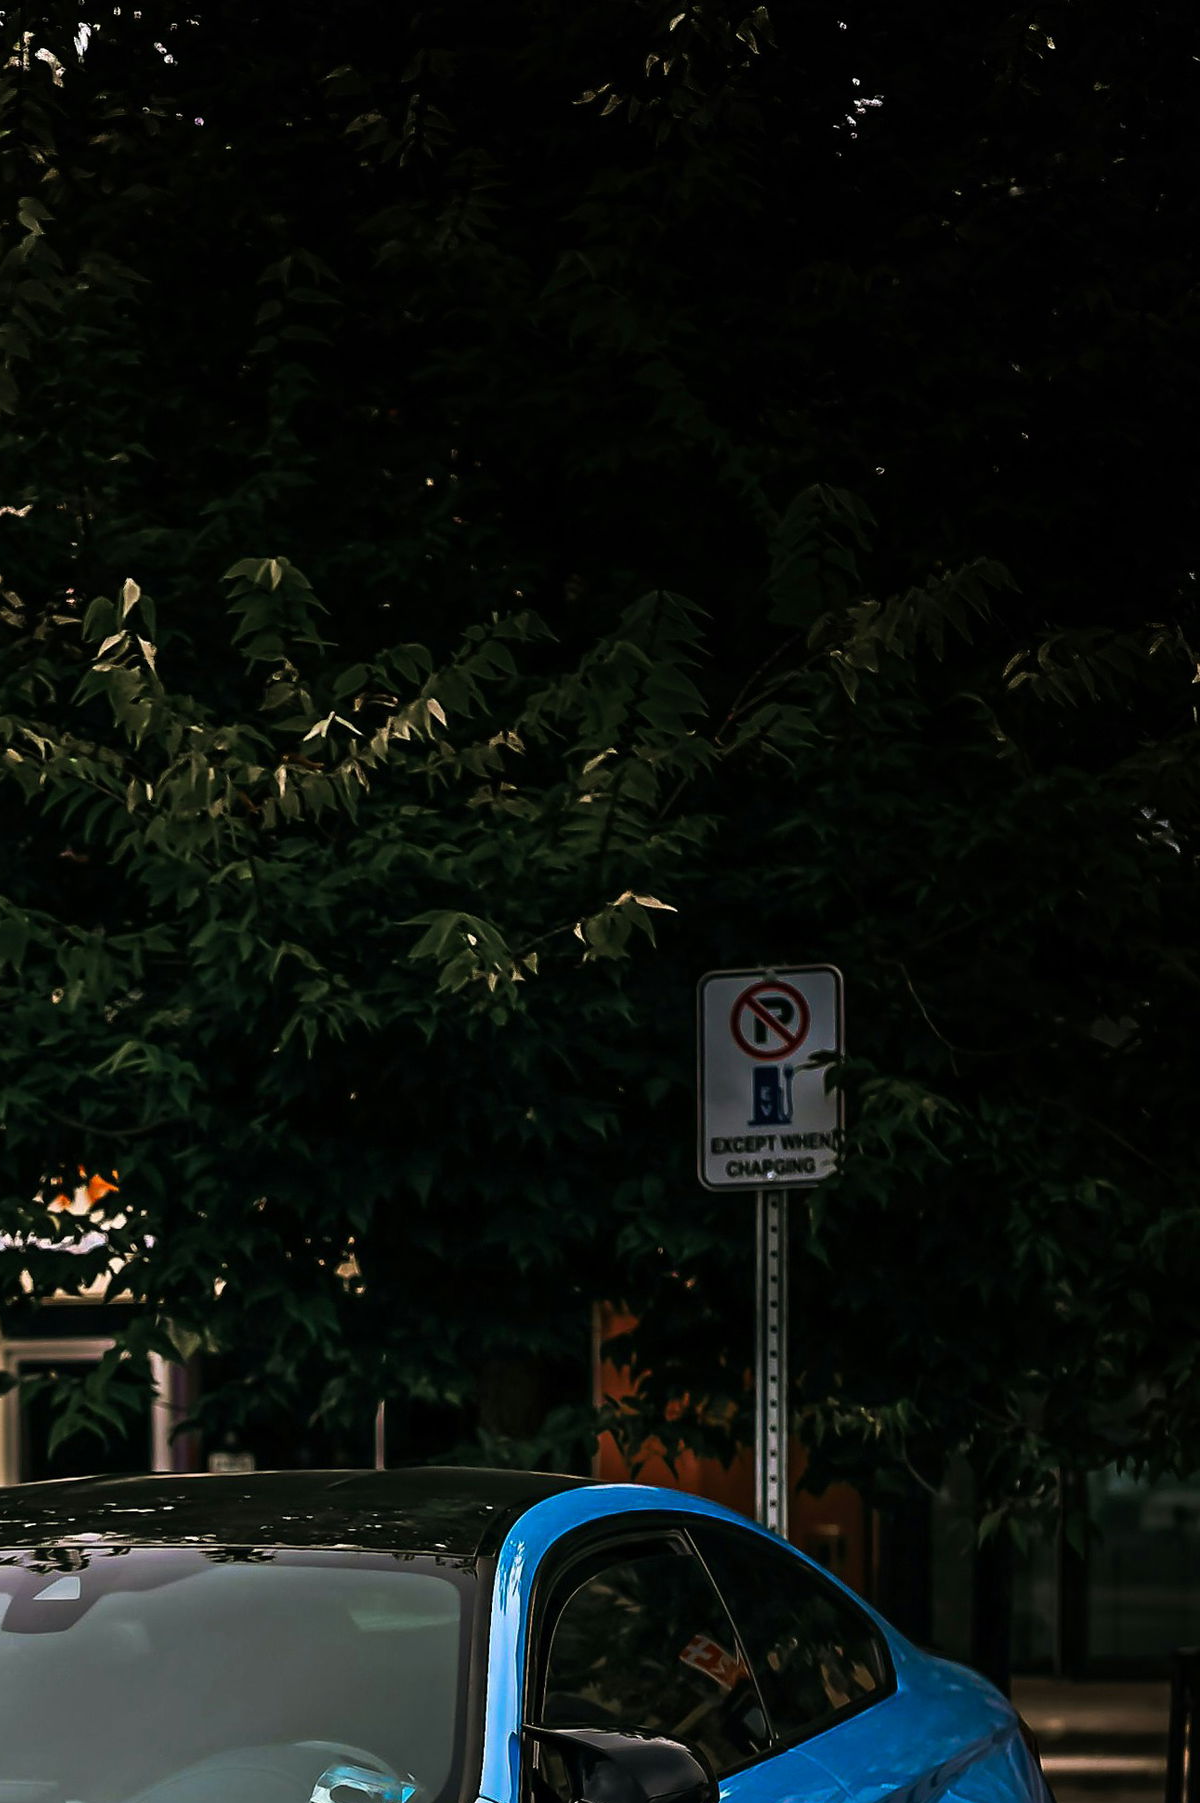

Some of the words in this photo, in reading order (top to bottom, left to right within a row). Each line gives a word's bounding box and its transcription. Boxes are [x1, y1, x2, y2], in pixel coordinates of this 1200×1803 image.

[711, 1135, 776, 1154] EXCEPT
[780, 1132, 833, 1151] WHEN
[726, 1157, 816, 1177] CHARGING
